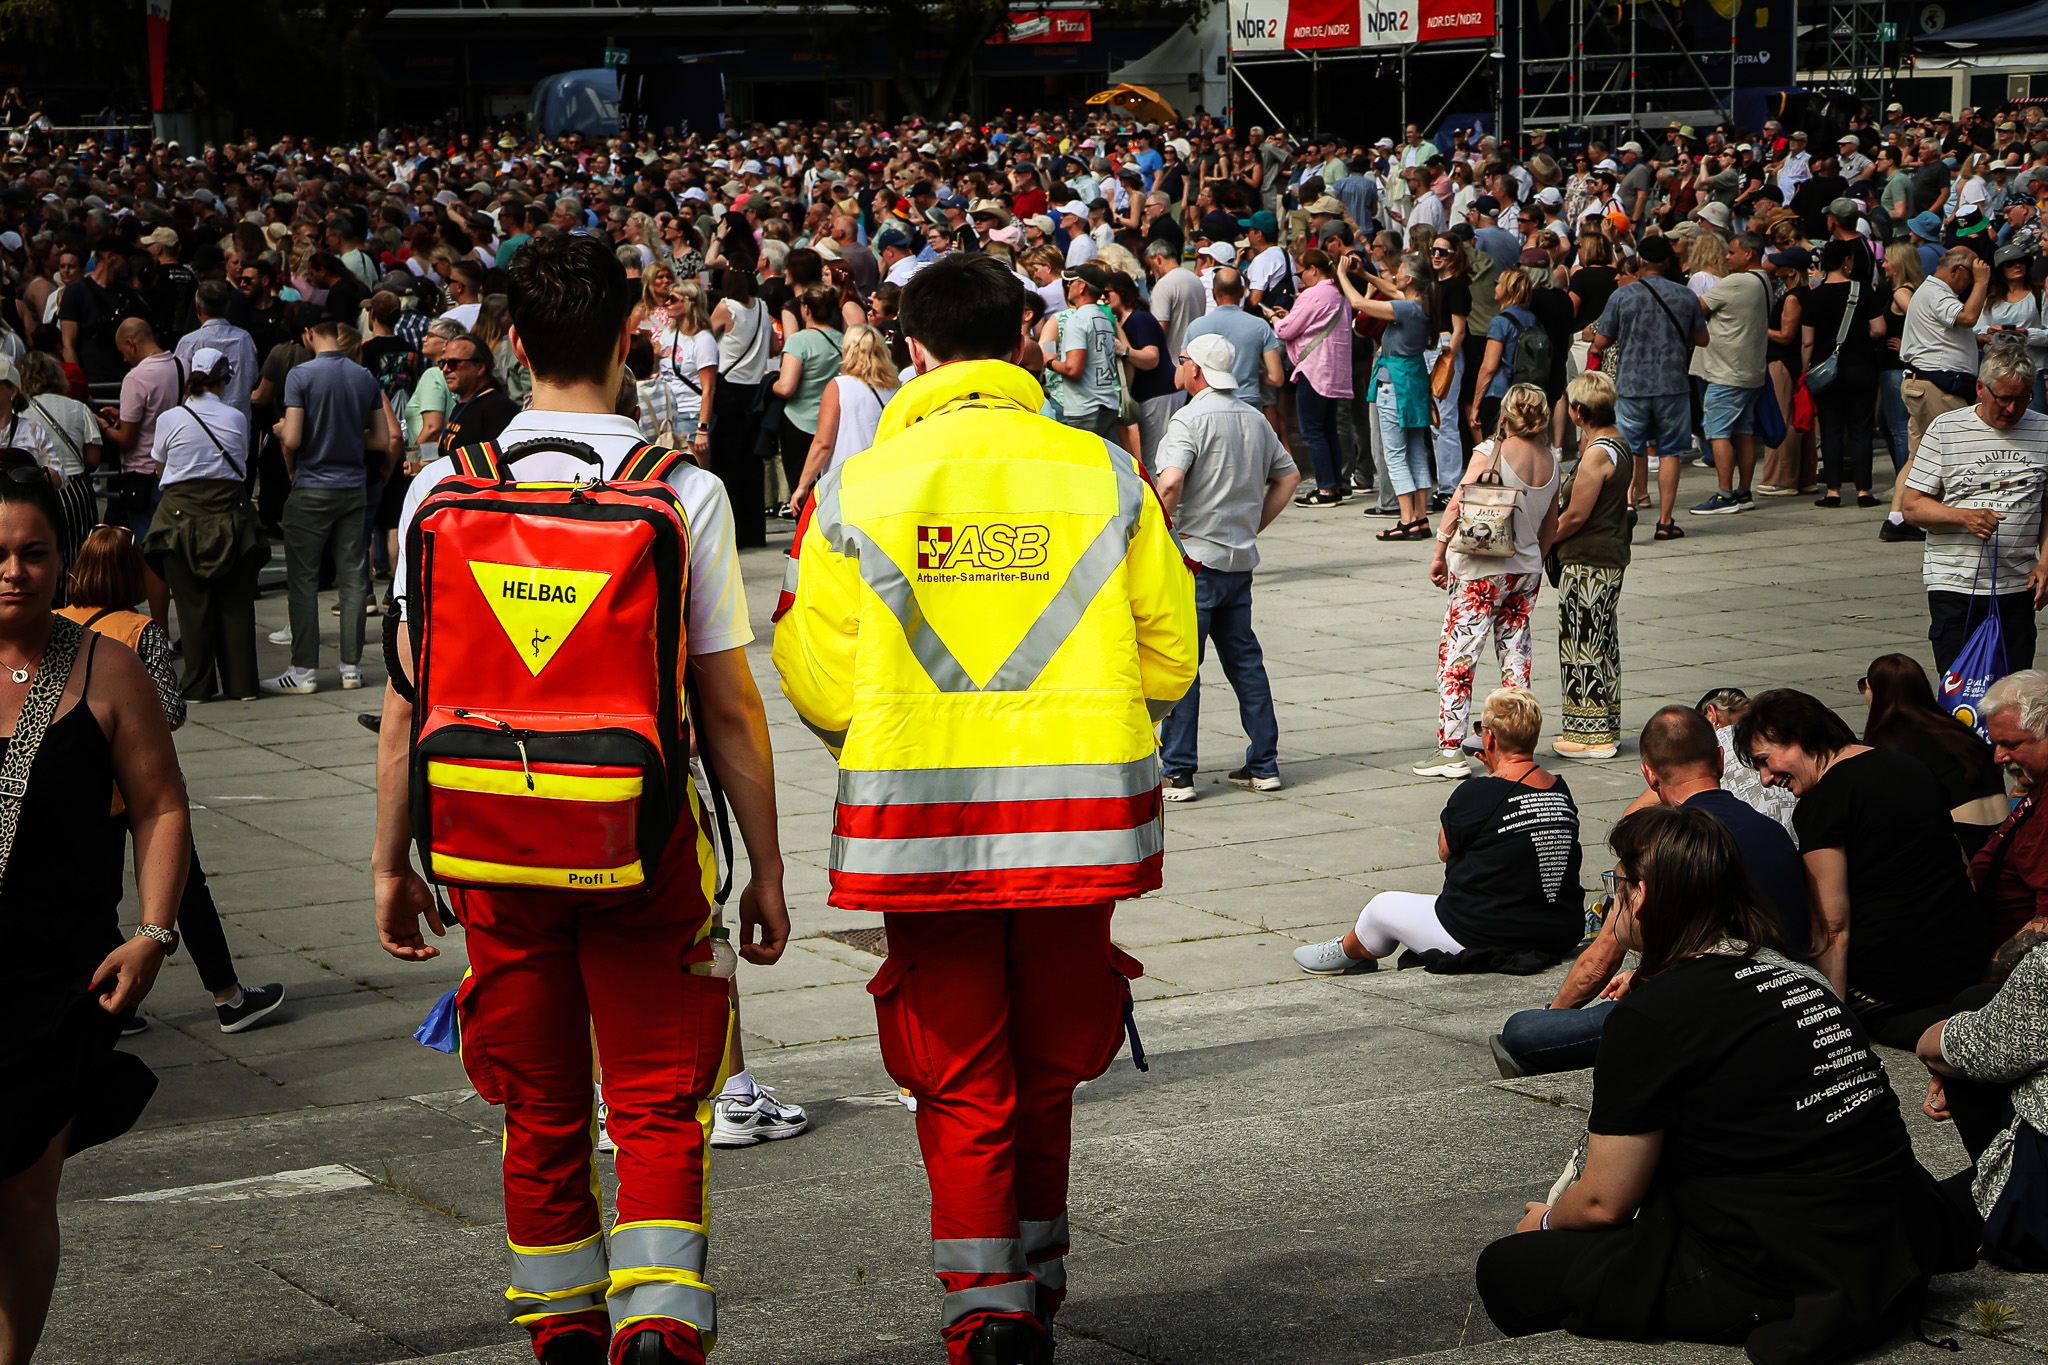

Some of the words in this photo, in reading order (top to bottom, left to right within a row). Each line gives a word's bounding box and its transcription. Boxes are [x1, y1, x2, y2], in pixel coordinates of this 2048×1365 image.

[1056, 19, 1085, 32] Pizza
[1427, 12, 1482, 29] NDR.DE/NDR2
[1293, 23, 1350, 39] NDR.DE/NDR2
[1975, 450, 2033, 467] NAUTICAL
[940, 523, 1050, 570] ASB
[916, 571, 1050, 582] Arbeiter-Samariter-Bund
[502, 580, 577, 604] HELBAG
[1506, 819, 1540, 831] MITGEGANGEN
[568, 873, 604, 884] Profi
[610, 873, 618, 884] L
[1781, 988, 1824, 1009] FREIBURG
[1796, 1005, 1842, 1028] KEMPTEN
[1812, 1028, 1852, 1049] COBURG
[1827, 1045, 1852, 1059] 06.07.23
[1813, 1049, 1867, 1076] CH-MURTEN
[1796, 1068, 1881, 1111] LUX-ESCH/ALZE
